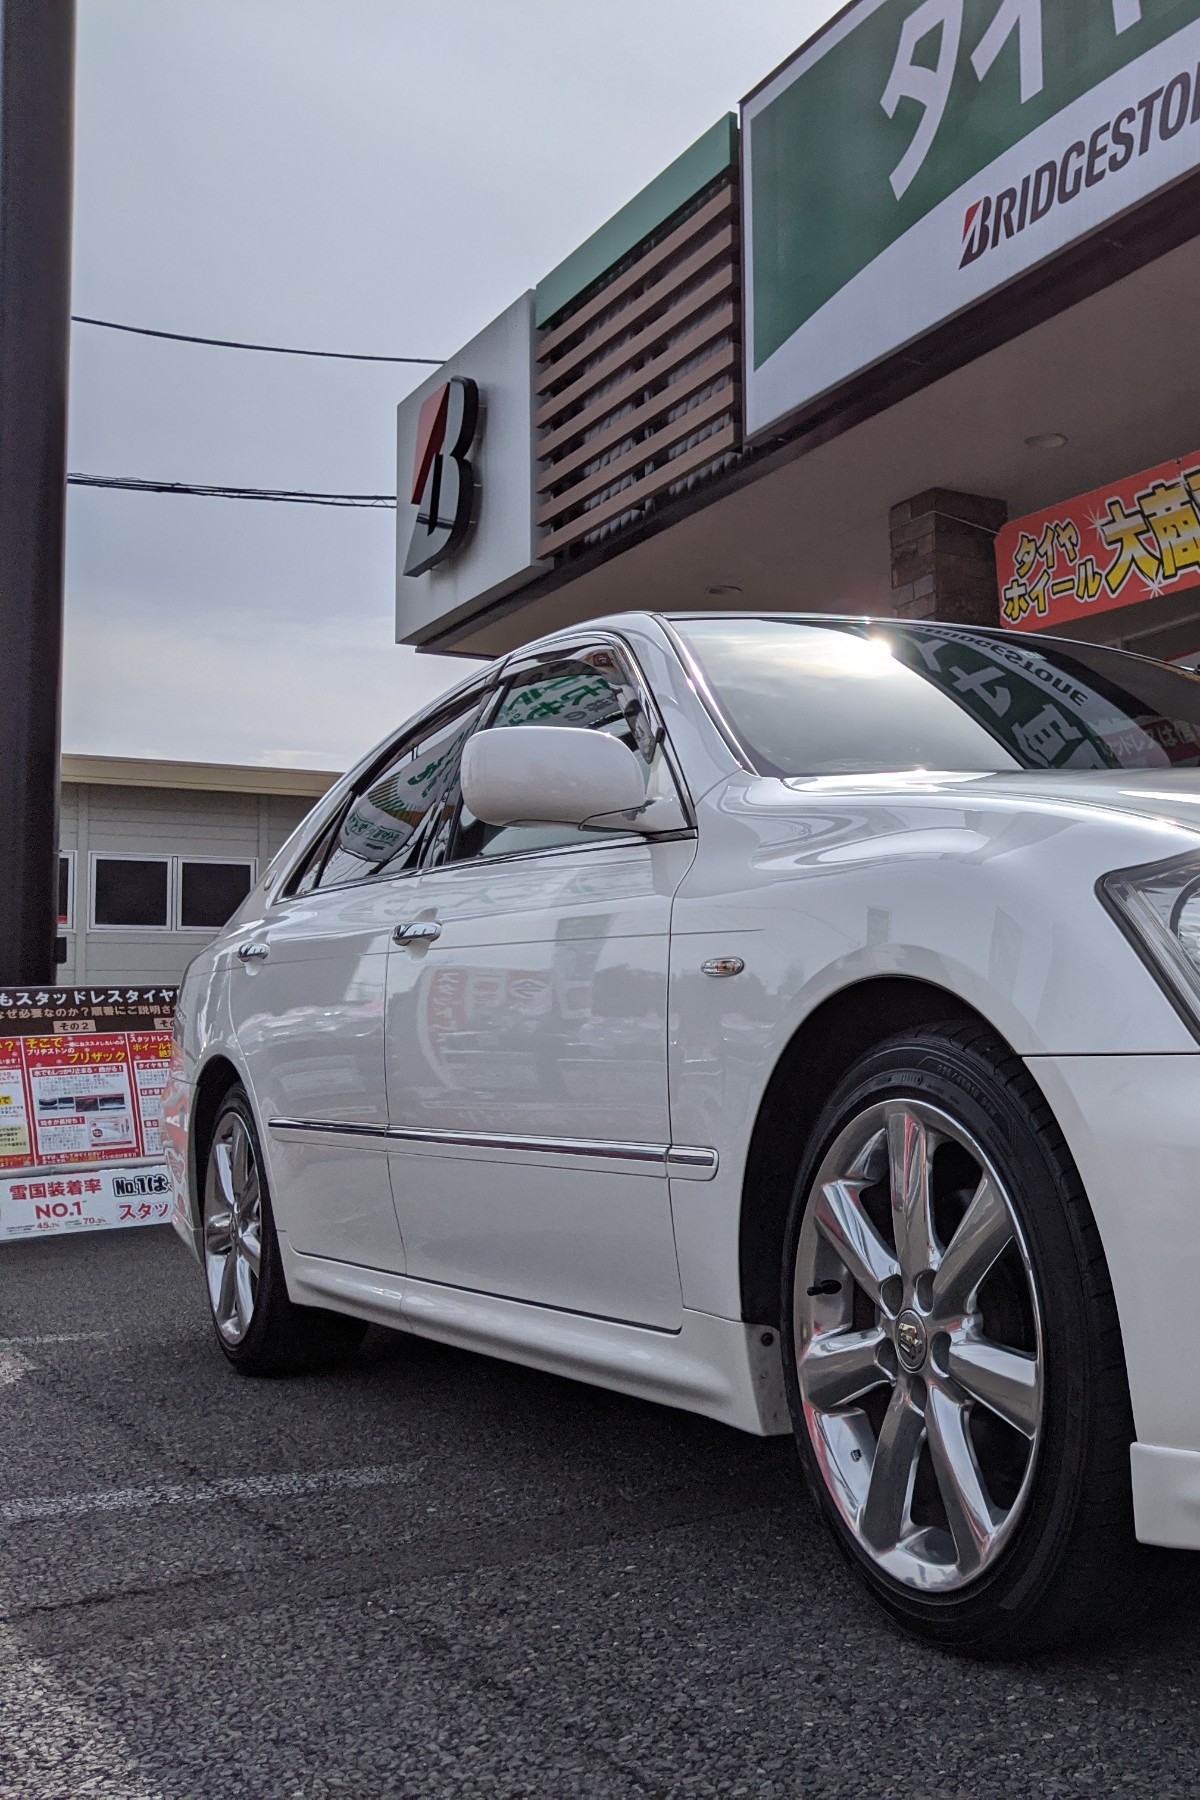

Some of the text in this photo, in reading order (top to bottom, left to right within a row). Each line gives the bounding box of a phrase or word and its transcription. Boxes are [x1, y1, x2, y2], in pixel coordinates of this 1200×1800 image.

[1013, 519, 1081, 579] タイヤ
[1002, 556, 1103, 623] ホイール
[0, 990, 179, 1006] もスタッドレスタイヤ
[130, 1034, 173, 1043] スタッドレス
[9, 1178, 103, 1201] 雪国装着率
[35, 1201, 83, 1219] NO.1
